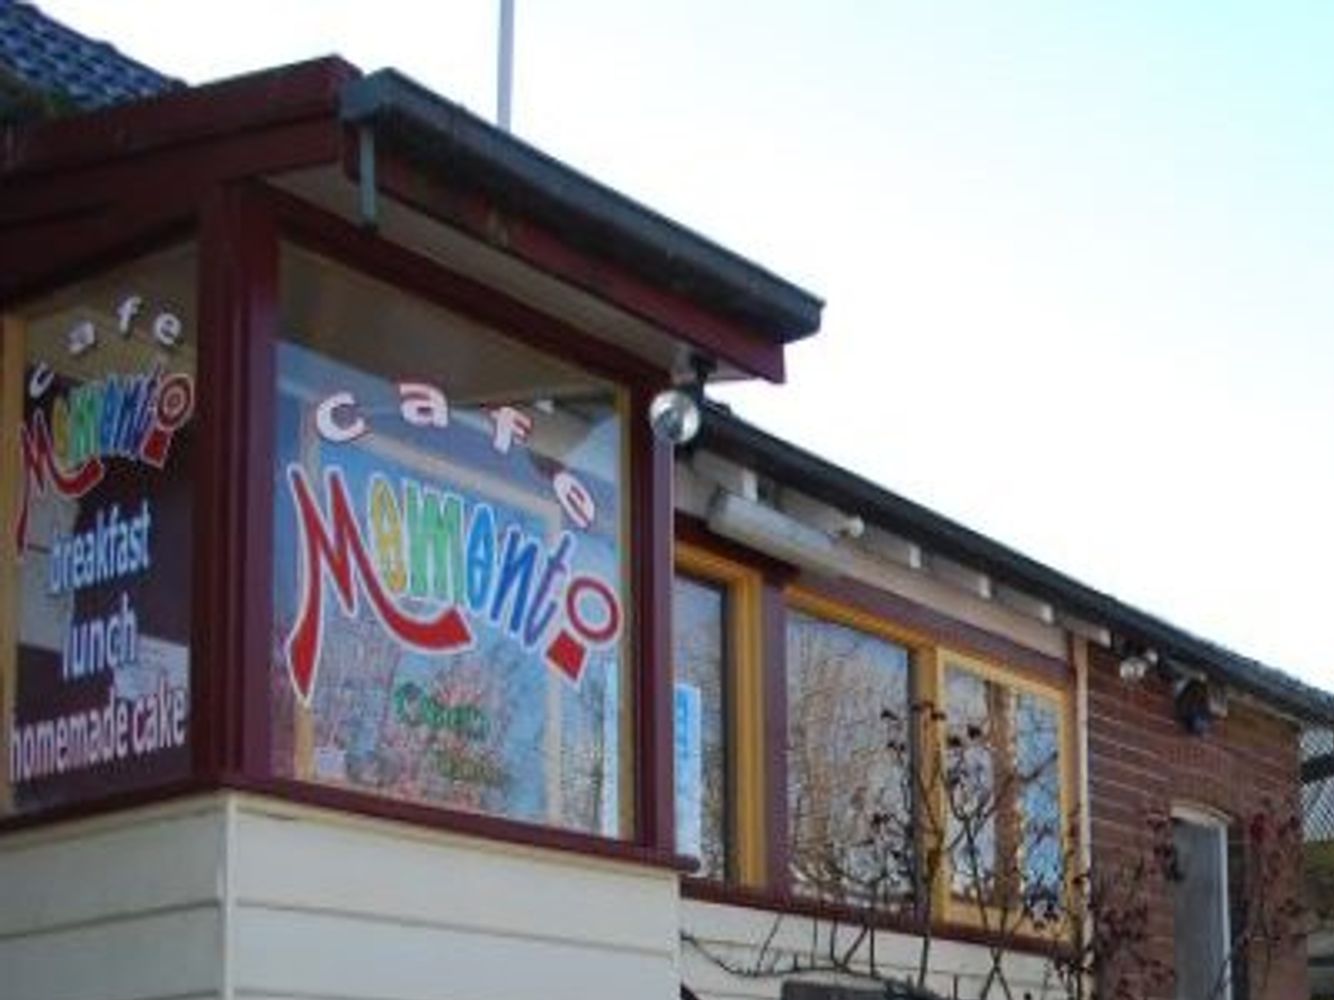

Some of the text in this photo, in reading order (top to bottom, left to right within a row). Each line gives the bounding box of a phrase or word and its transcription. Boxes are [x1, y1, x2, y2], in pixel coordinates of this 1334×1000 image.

[29, 296, 183, 399] cafe
[315, 382, 595, 527] cafe
[50, 499, 150, 594] breakfast
[287, 463, 622, 706] Memento
[62, 591, 137, 682] lunch
[9, 676, 186, 785] homemade cake
